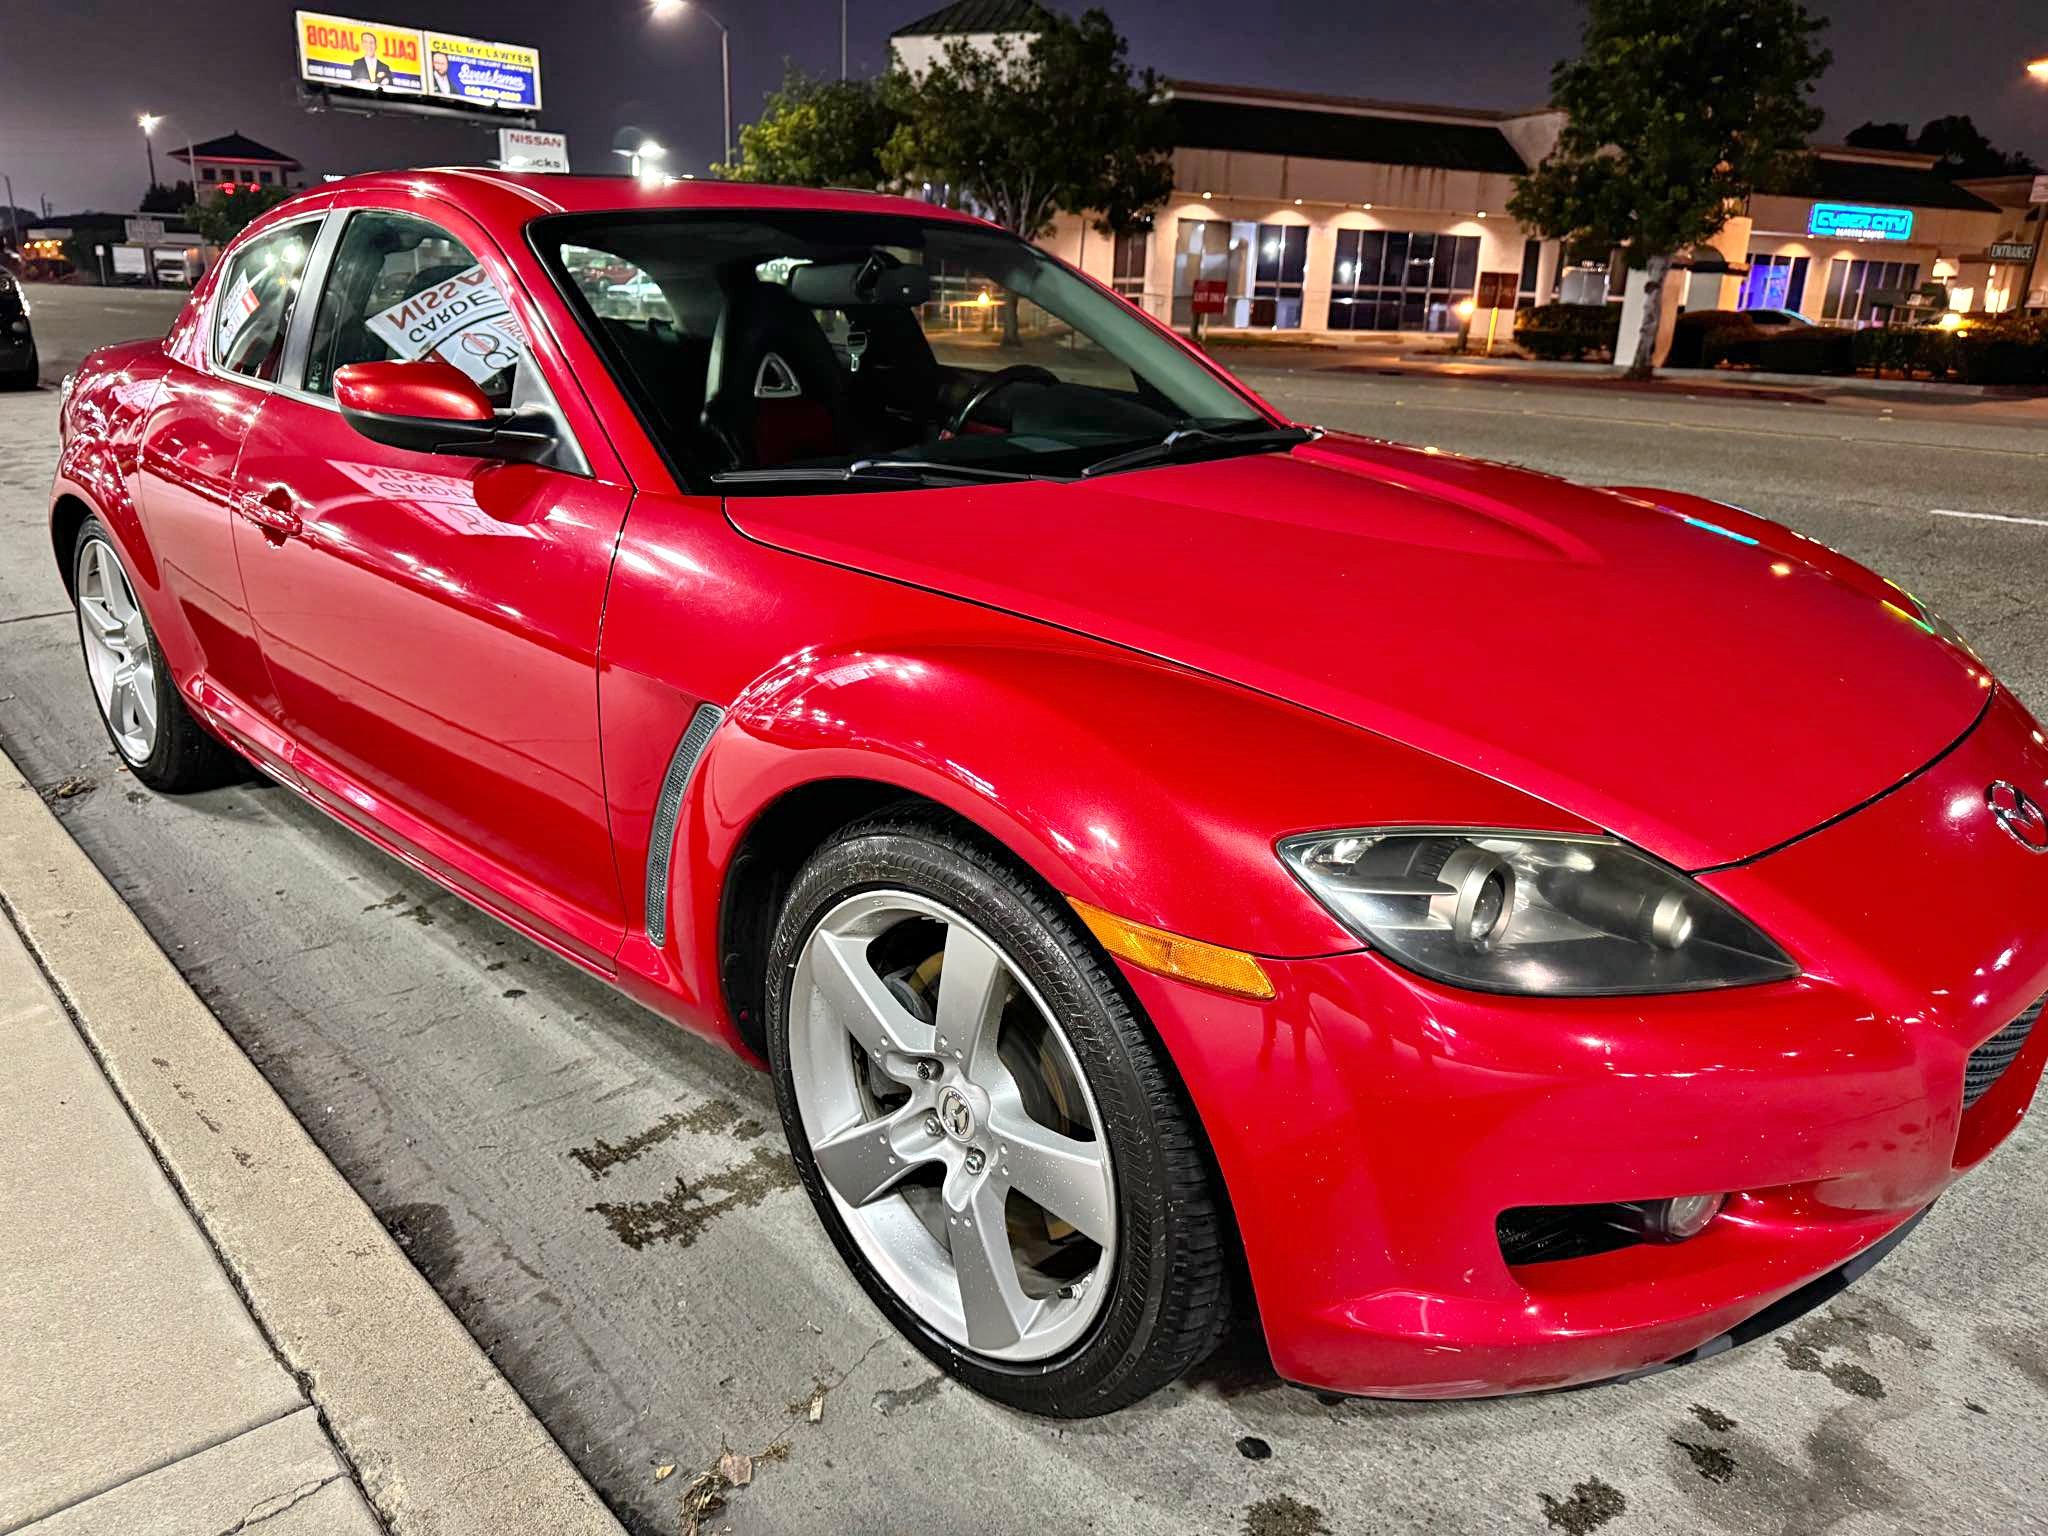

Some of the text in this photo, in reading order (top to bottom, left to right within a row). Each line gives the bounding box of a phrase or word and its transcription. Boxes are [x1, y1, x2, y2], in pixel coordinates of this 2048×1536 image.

[432, 41, 462, 53] CALL
[466, 46, 481, 54] MY
[486, 50, 532, 63] LAWYER
[510, 133, 561, 148] NISSAN
[1991, 245, 2032, 259] ENTRANCE
